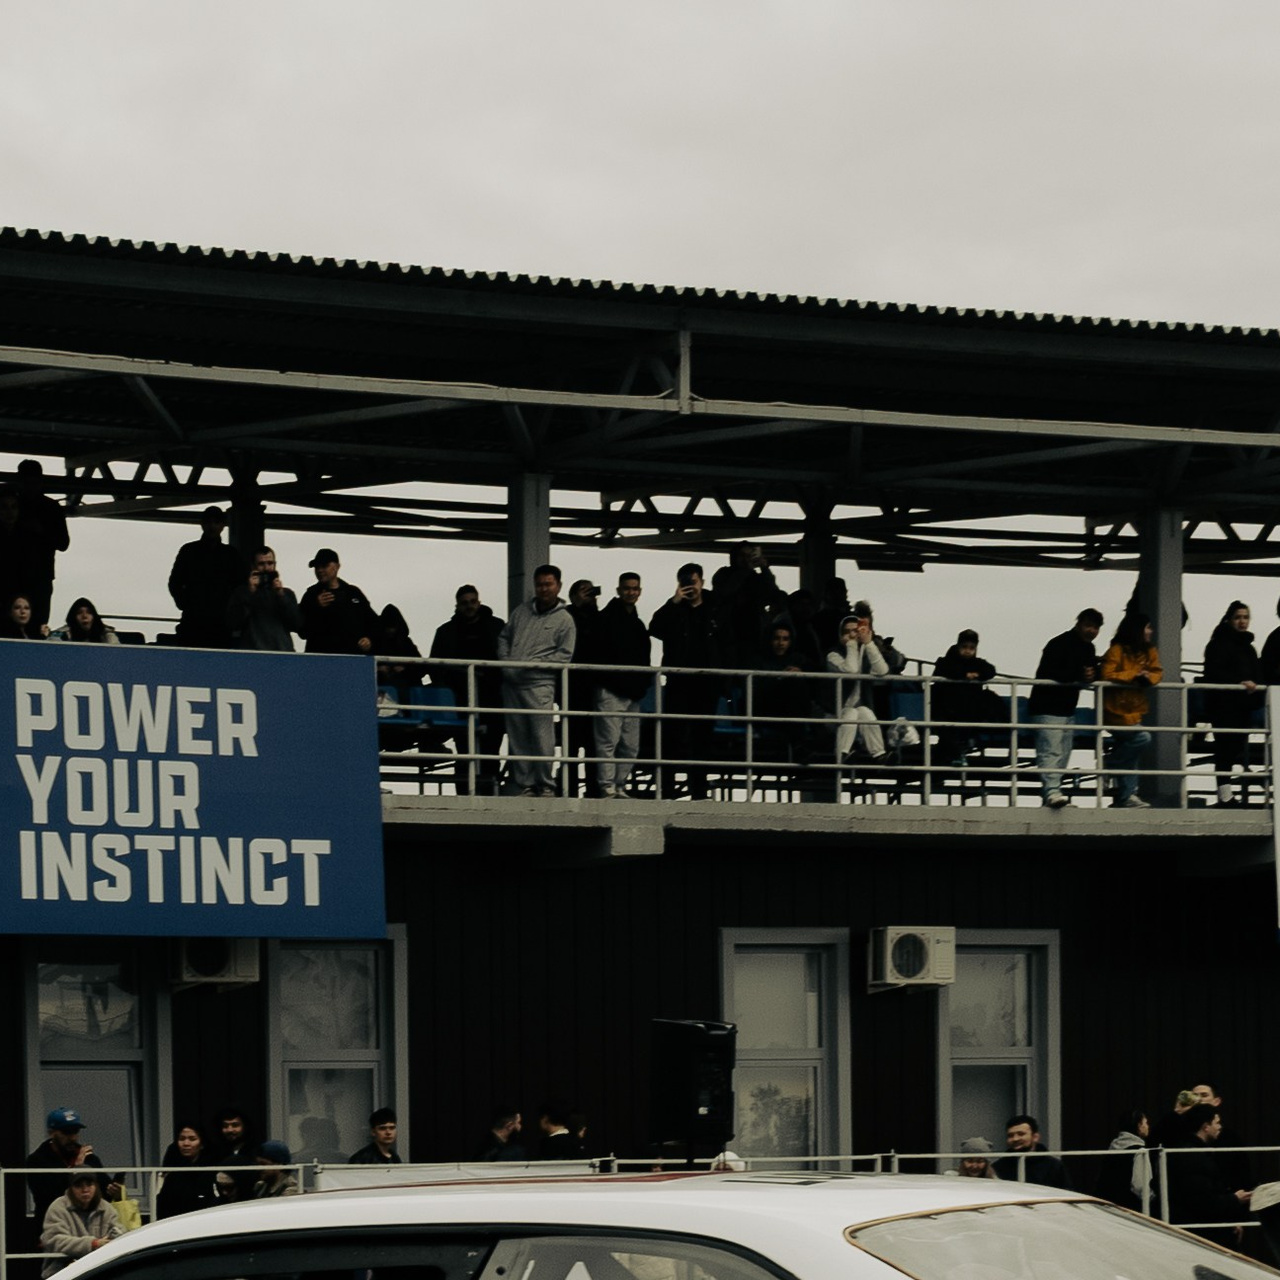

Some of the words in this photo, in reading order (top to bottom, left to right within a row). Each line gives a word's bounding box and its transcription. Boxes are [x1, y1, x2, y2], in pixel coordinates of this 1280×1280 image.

[15, 678, 259, 757] POWER
[15, 754, 200, 829] YOUR
[20, 830, 332, 906] INSTINCT
